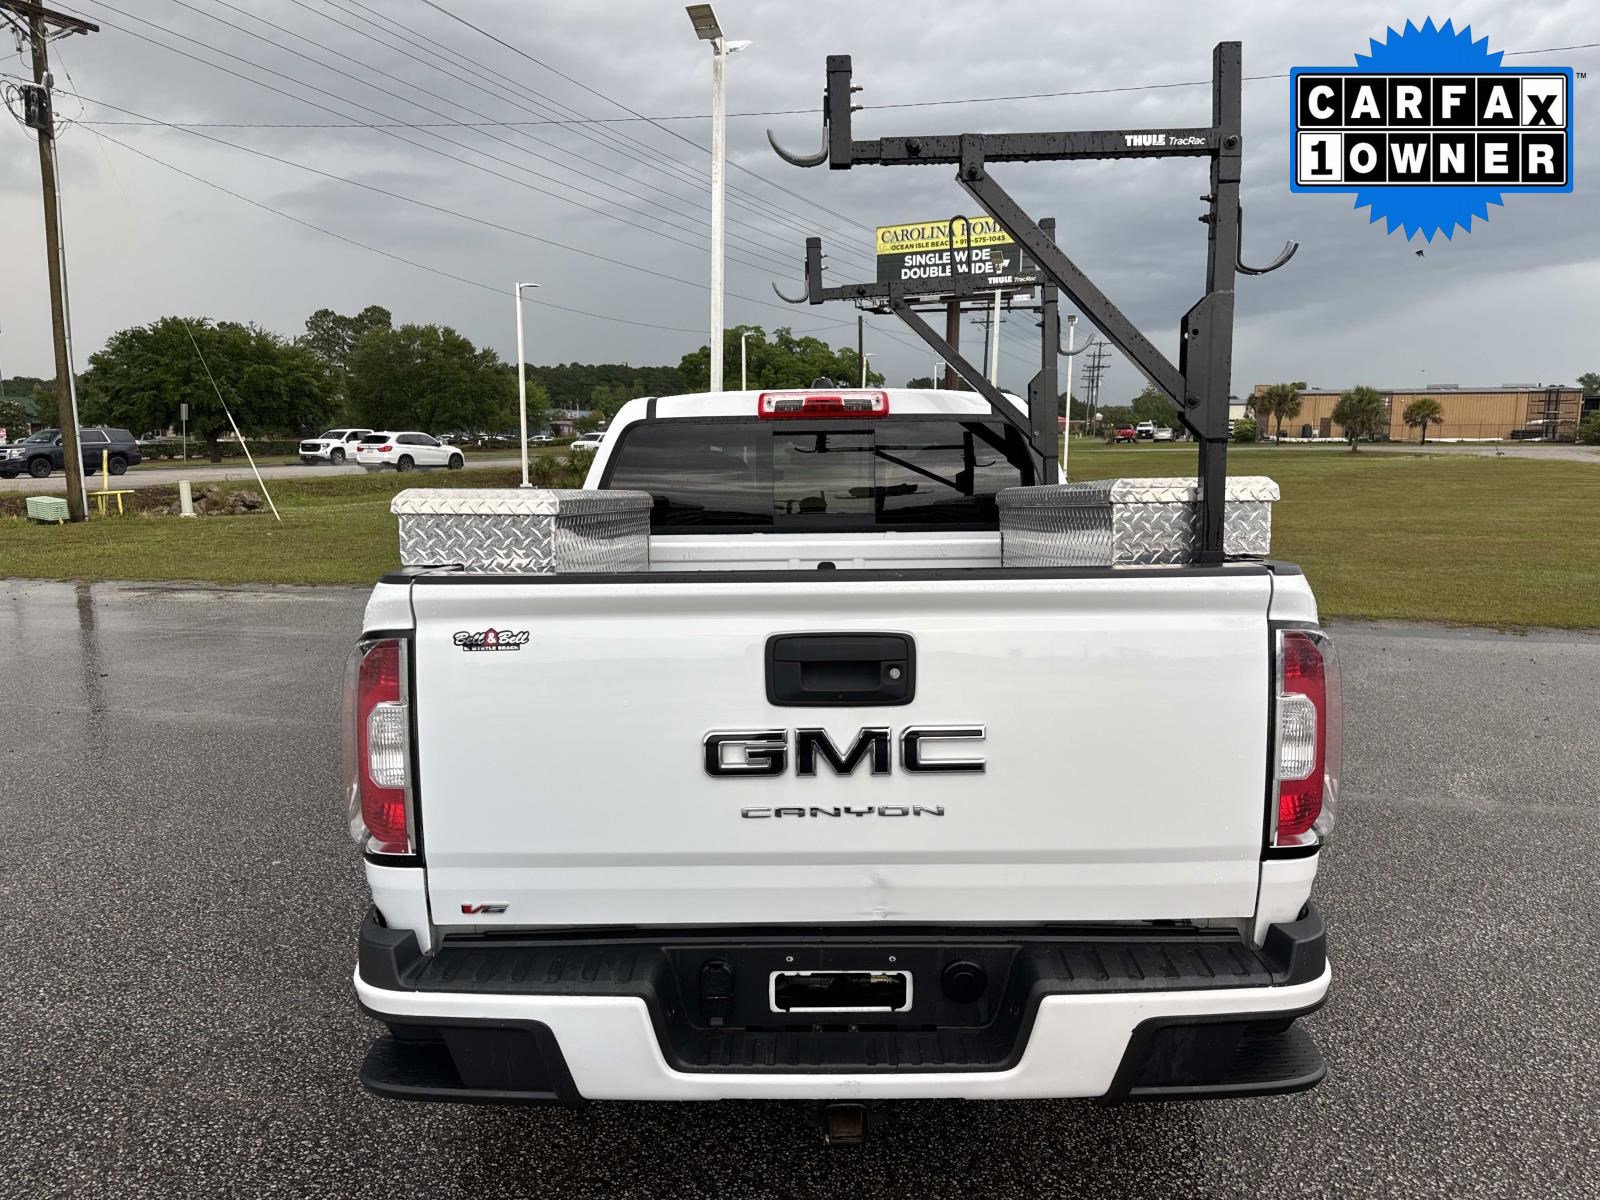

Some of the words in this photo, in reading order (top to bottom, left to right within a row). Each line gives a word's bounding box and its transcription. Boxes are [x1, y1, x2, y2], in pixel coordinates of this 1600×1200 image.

[1125, 134, 1166, 147] THULE
[1169, 136, 1206, 146] TracRac
[961, 221, 1003, 236] HOM
[930, 240, 951, 248] BEAC
[959, 235, 1006, 245] 91-575-1045
[904, 252, 951, 267] SINGLE
[954, 248, 991, 262] WDE
[901, 265, 952, 280] DOUBLE
[957, 262, 994, 274] WIDE
[988, 276, 1013, 284] THULE
[454, 632, 486, 645] Bell
[486, 632, 497, 644] &
[498, 631, 529, 645] Bell
[703, 725, 986, 777] GMC
[741, 805, 945, 818] CANYON
[461, 903, 509, 914] V6
